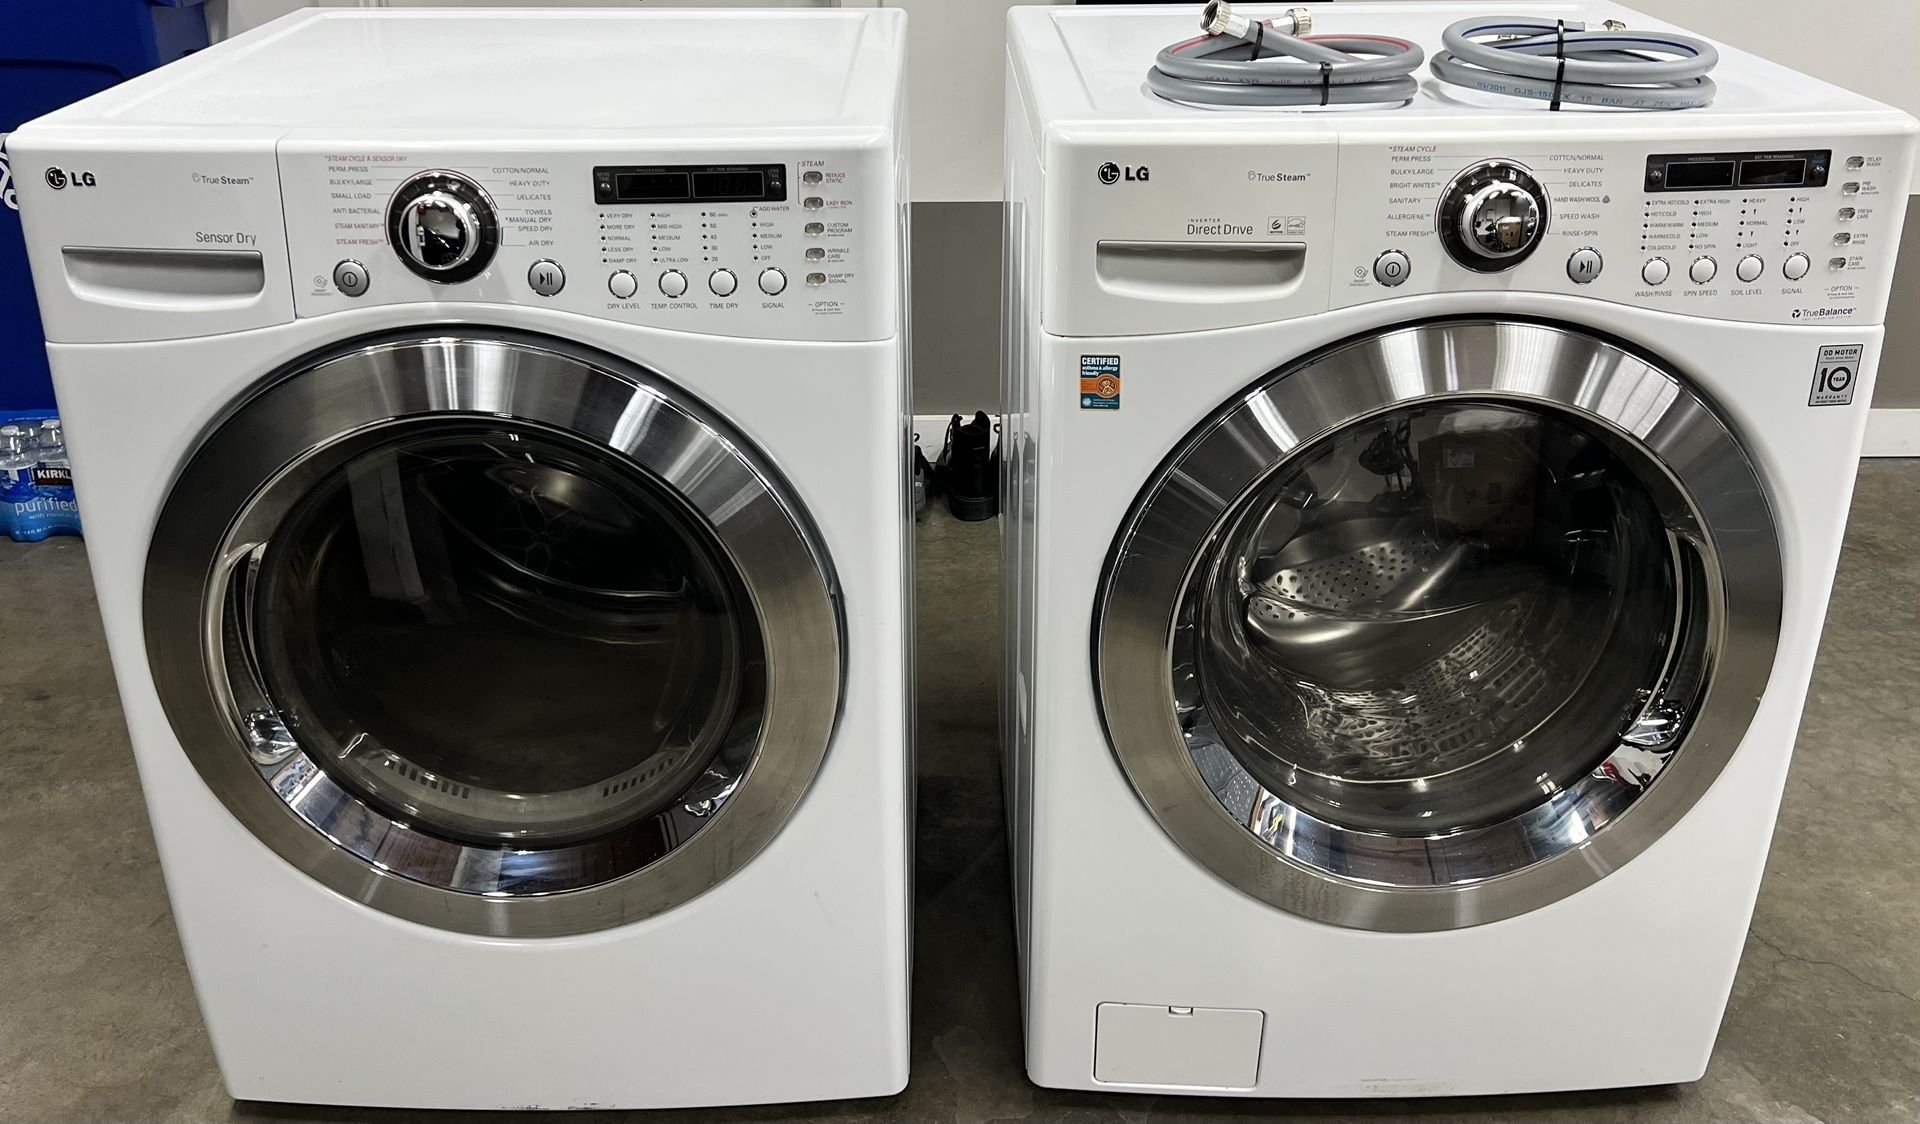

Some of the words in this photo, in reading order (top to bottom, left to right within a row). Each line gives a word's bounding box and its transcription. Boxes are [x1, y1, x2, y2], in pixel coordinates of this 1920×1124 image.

[1601, 97, 1624, 105] BAR
[1125, 166, 1150, 182] LG
[70, 171, 97, 187] LG
[331, 192, 353, 200] SMALL
[353, 192, 372, 200] LOAD
[1553, 195, 1569, 203] HAND
[332, 207, 347, 215] ANTI
[348, 207, 381, 215] BACTERIAL
[1187, 223, 1222, 235] Direct
[1223, 223, 1253, 235] Drive
[195, 231, 234, 243] Sensor
[236, 232, 257, 246] Dry
[1780, 287, 1804, 295] SIGNAL
[1834, 348, 1858, 356] MOTOR
[1081, 357, 1119, 365] CERTIFIED
[1818, 366, 1852, 393] 10
[14, 497, 78, 517] purified
